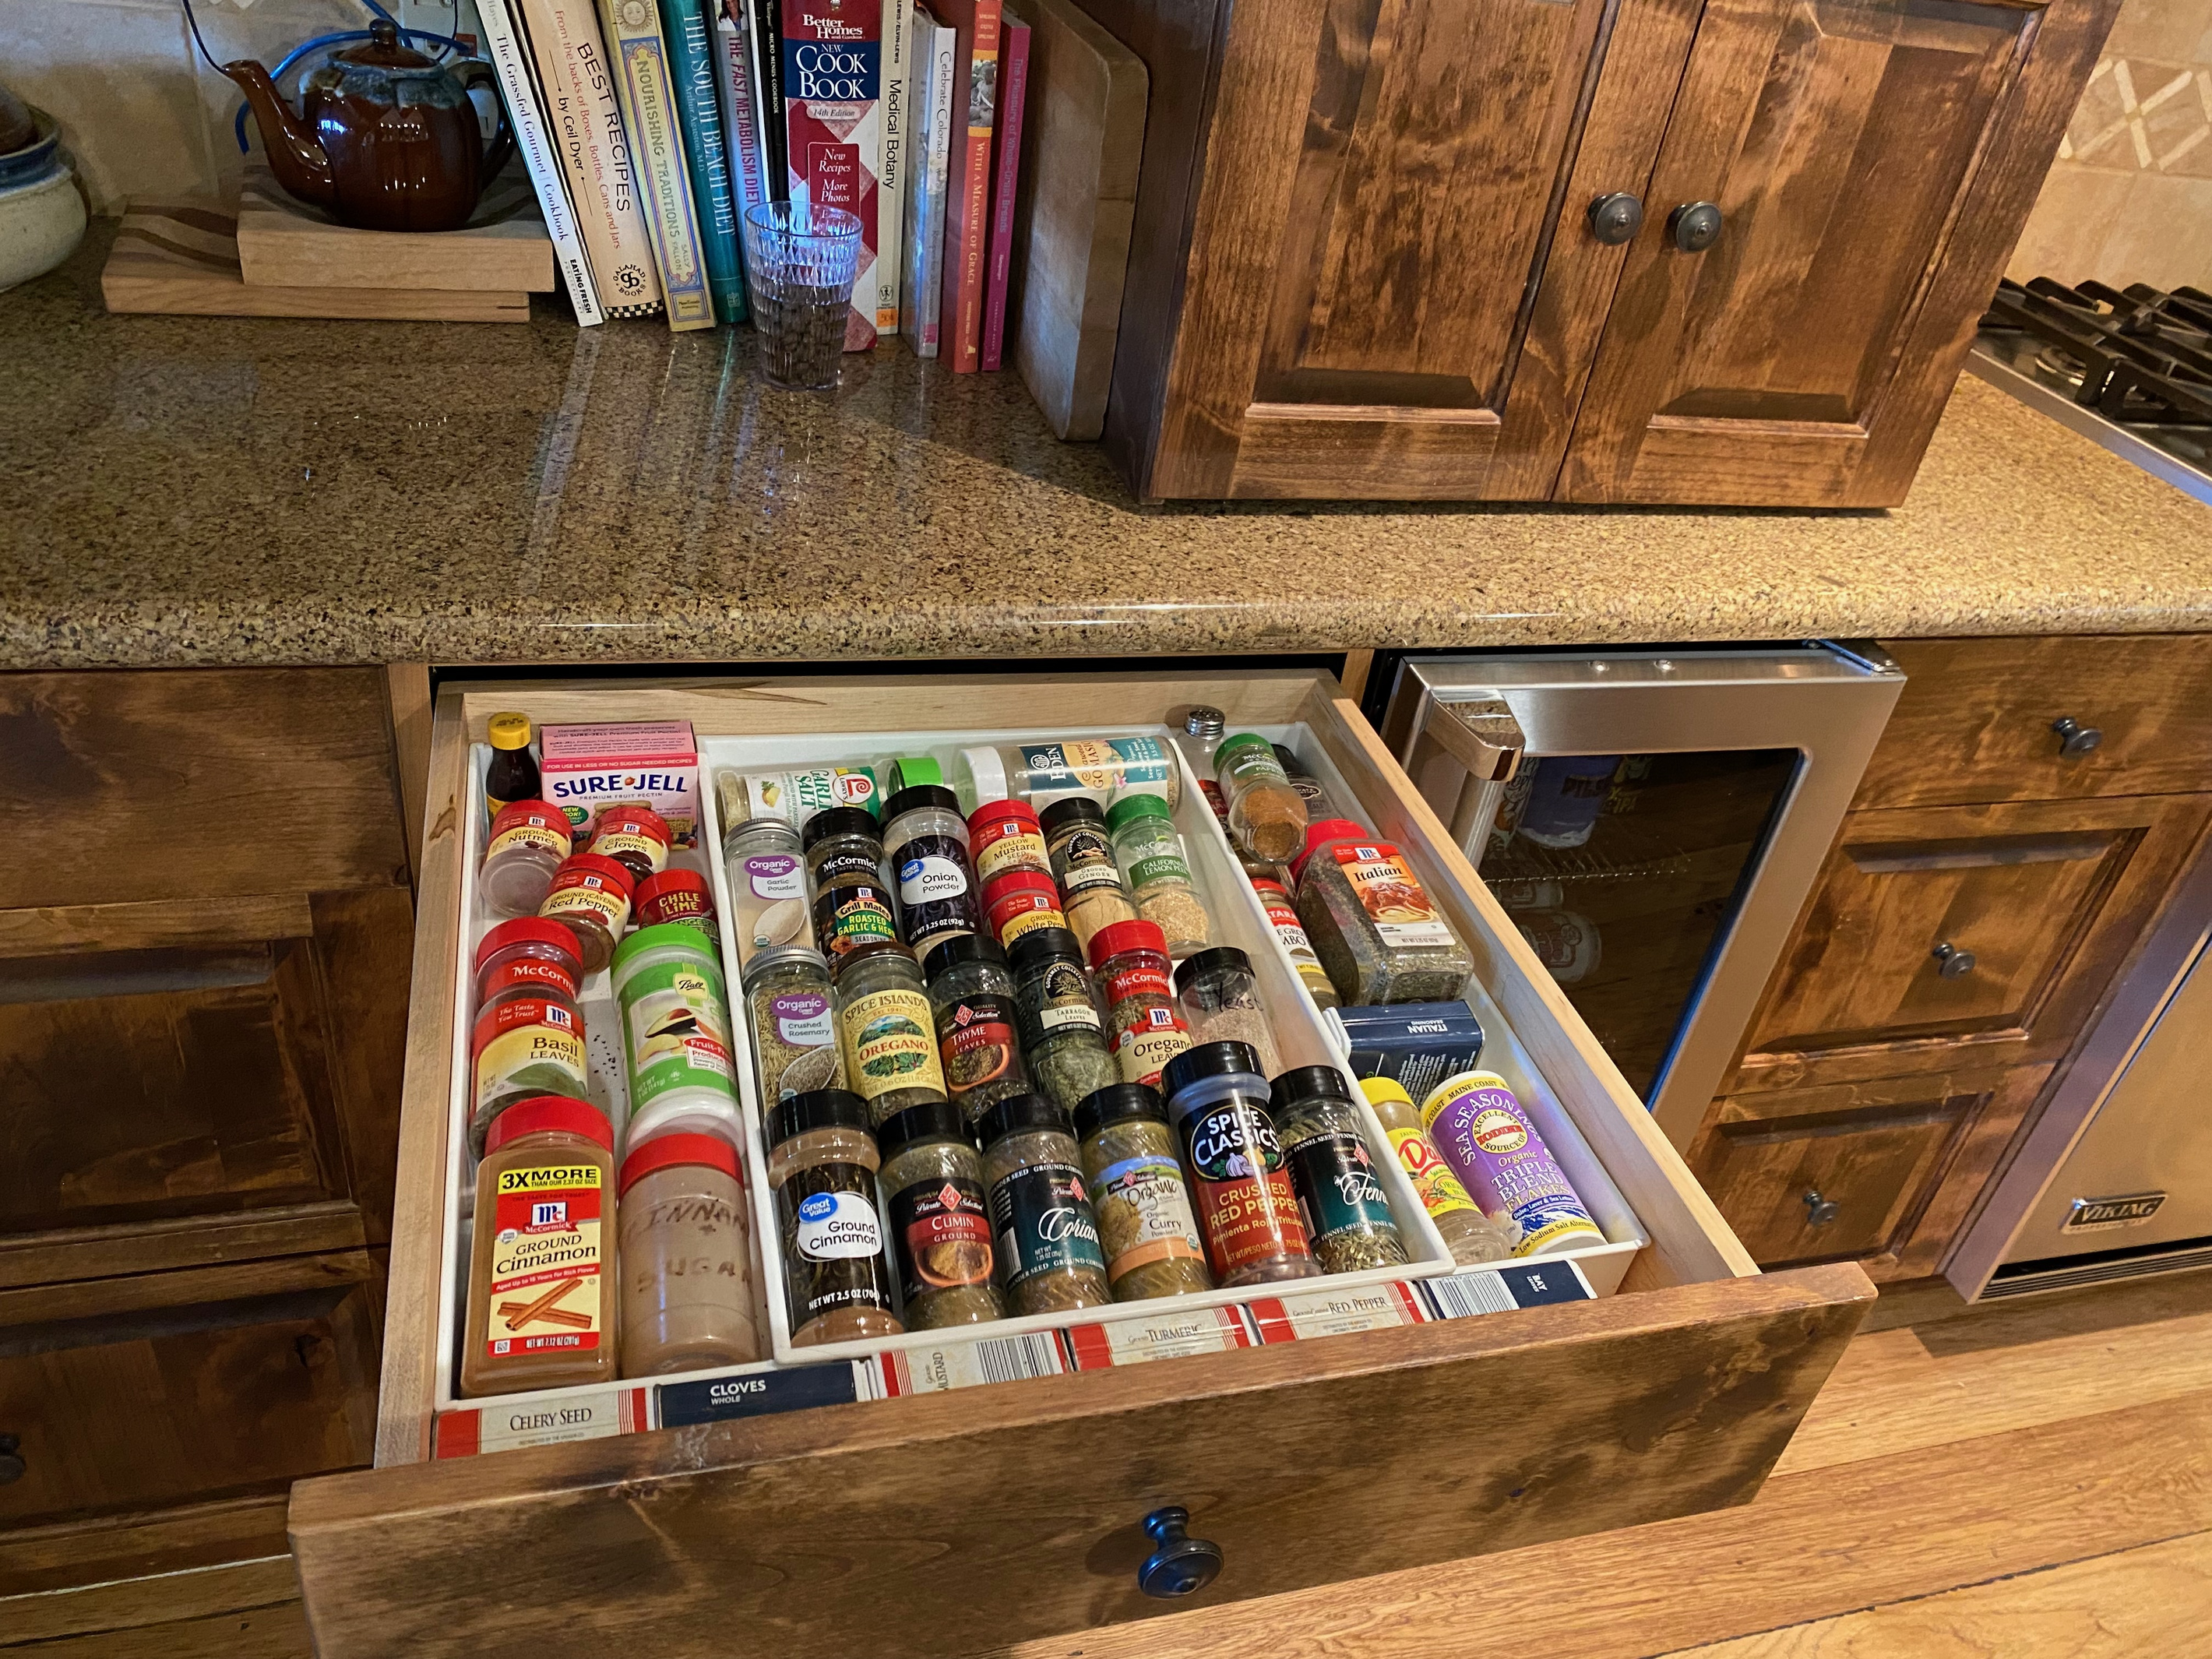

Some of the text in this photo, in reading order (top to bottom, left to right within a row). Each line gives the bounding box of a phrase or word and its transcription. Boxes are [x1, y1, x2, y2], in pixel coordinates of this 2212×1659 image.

[555, 11, 568, 39] From
[802, 14, 844, 27] Better
[817, 26, 863, 39] Homes
[564, 43, 573, 60] the
[821, 44, 844, 52] NEW
[569, 63, 583, 93] backs
[577, 97, 586, 107] of
[936, 51, 951, 159] Celebrate Colorado
[814, 107, 829, 116] 14th
[577, 43, 630, 212] BEST RECIPES
[684, 12, 735, 235] THE SOUTH BEACH DIET
[728, 37, 760, 204] THE FAST METABOLISM DIET
[497, 33, 568, 241] The Grassfed Gourmet Cookbook
[558, 97, 584, 171] by Ceil Dyer
[883, 79, 901, 189] Medical Botany
[637, 60, 680, 238] NOURISHING TRADITIONS
[824, 149, 846, 160] New
[977, 143, 985, 171] WITH
[819, 160, 851, 174] Recipes
[823, 180, 847, 191] More
[599, 185, 610, 209] Cans
[821, 191, 850, 203] Photos
[972, 184, 981, 232] MEASURE
[606, 212, 618, 230] and
[609, 232, 621, 249] Jars
[970, 235, 977, 249] OF
[672, 241, 682, 270] FALLON
[682, 245, 690, 268] SALLY
[967, 252, 977, 286] GRACE
[553, 774, 688, 798] SURE JELL
[795, 776, 817, 810] SALT
[508, 834, 558, 849] Nutmeg
[515, 829, 555, 839] GROUND
[608, 837, 647, 846] GROUND
[604, 841, 646, 852] Cloves
[994, 843, 1036, 860] Mustard
[999, 839, 1028, 850] YELLOW
[750, 859, 790, 870] Organic
[901, 864, 918, 877] Great
[1143, 859, 1185, 870] CALIFORNIA
[1145, 865, 1172, 875] LEMON
[922, 874, 958, 883] Onion
[1353, 866, 1403, 882] Italian
[922, 883, 960, 893] Powder
[550, 891, 584, 903] GROUND
[548, 898, 618, 918] Red Pepper
[840, 902, 889, 919] Grill Mates
[837, 922, 870, 935] GARLIC
[849, 915, 886, 925] ROASTED
[917, 926, 925, 935] WT
[925, 921, 939, 930] 3.25
[678, 979, 705, 991] Ball
[1046, 966, 1060, 988] GOURMET
[777, 999, 821, 1010] Organic
[1214, 982, 1264, 1012] Yeast
[845, 996, 927, 1023] SPICE ISLANDS
[952, 1027, 986, 1046] THYME
[1407, 1024, 1447, 1034] ITALIAN
[533, 1037, 577, 1056] Basil
[860, 1040, 928, 1061] OREGANO
[956, 1039, 985, 1055] LEAVES
[530, 1051, 579, 1067] LEAVES
[1428, 1100, 1445, 1120] COAST
[1448, 1083, 1473, 1100] MAINE
[1207, 1111, 1262, 1134] SPICE
[1455, 1094, 1542, 1166] SEA SEASONINGS
[1474, 1110, 1519, 1135] EXCELLENT
[1194, 1128, 1281, 1165] CLASSICS
[1294, 1139, 1317, 1152] FENNEL
[1484, 1143, 1520, 1151] SOURCE
[1499, 1150, 1537, 1167] Organic
[502, 1169, 597, 1189] 3X MORE
[1012, 1164, 1064, 1180] SEED GROUND
[1491, 1161, 1557, 1190] TRIPLE
[1128, 1179, 1177, 1210] Organic
[1219, 1183, 1287, 1206] CRUSHED
[1498, 1173, 1562, 1203] BLEND
[802, 1199, 830, 1214] Great
[1506, 1184, 1570, 1213] FLAKES
[809, 1207, 830, 1217] Value
[1210, 1197, 1299, 1229] RED PEPPER
[2082, 1203, 2157, 1221] VIKING
[829, 1221, 875, 1234] Ground
[932, 1216, 974, 1230] CUMIN
[1150, 1218, 1182, 1230] Curry
[516, 1235, 582, 1255] GROUND
[810, 1234, 877, 1249] Cinnamon
[935, 1232, 975, 1242] GROUND
[1520, 1222, 1568, 1252] Low Sodium Salt
[496, 1246, 597, 1274] Cinnamon
[1532, 1273, 1548, 1291] BAY
[808, 1290, 861, 1310] NET WT 2.5 OZ
[1328, 1297, 1388, 1314] RED PEPPER
[557, 1337, 563, 1345] OZ
[1146, 1324, 1203, 1342] TURMERIC
[710, 1379, 766, 1397] CLOVES
[711, 1395, 741, 1405] WHOLE
[510, 1408, 592, 1432] CELERY SEED
